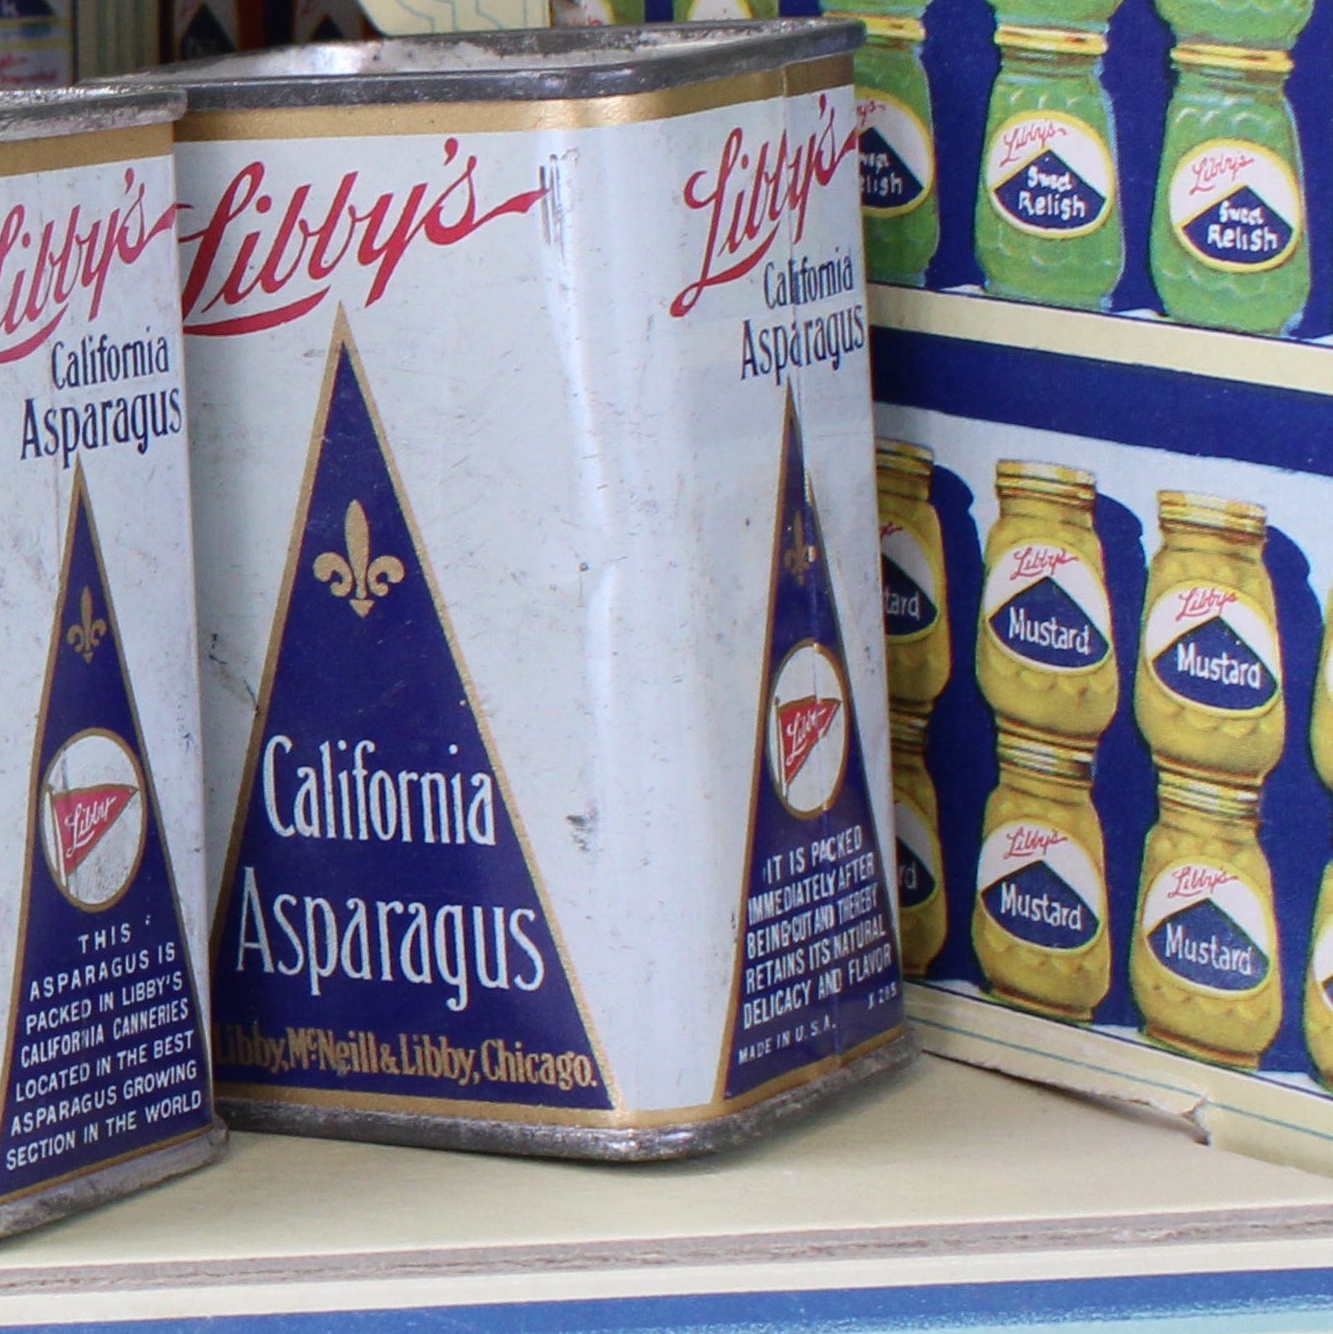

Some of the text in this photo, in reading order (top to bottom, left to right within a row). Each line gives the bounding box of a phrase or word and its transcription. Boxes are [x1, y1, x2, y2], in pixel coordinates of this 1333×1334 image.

[668, 94, 861, 319] Libby's
[762, 249, 856, 311] California
[49, 329, 171, 392] California
[739, 299, 867, 385] Asparagus
[17, 393, 183, 469] Asparagus
[1007, 604, 1091, 655] Mustard
[1176, 643, 1262, 690] Mustard
[261, 734, 496, 849] California
[78, 926, 132, 954] THIS
[237, 865, 546, 1014] Asparagus
[999, 888, 1084, 933] Mustard
[29, 941, 176, 1002] ASPARAGUS IS
[745, 945, 806, 995] RETAINS
[1163, 927, 1255, 979] Mustard
[25, 970, 184, 1035] PACKED IN LIBBY'S
[743, 942, 893, 1030] DELICACY AND FLAVOR
[15, 1028, 195, 1103] LOCATED IN THE BEST
[19, 997, 190, 1069] CALIFORNIA CANNERIES
[9, 1058, 198, 1137] ASPARAGUS GROWING
[482, 1040, 598, 1092] Chicago.
[4, 1088, 203, 1171] SECTION IN THE WORLD
